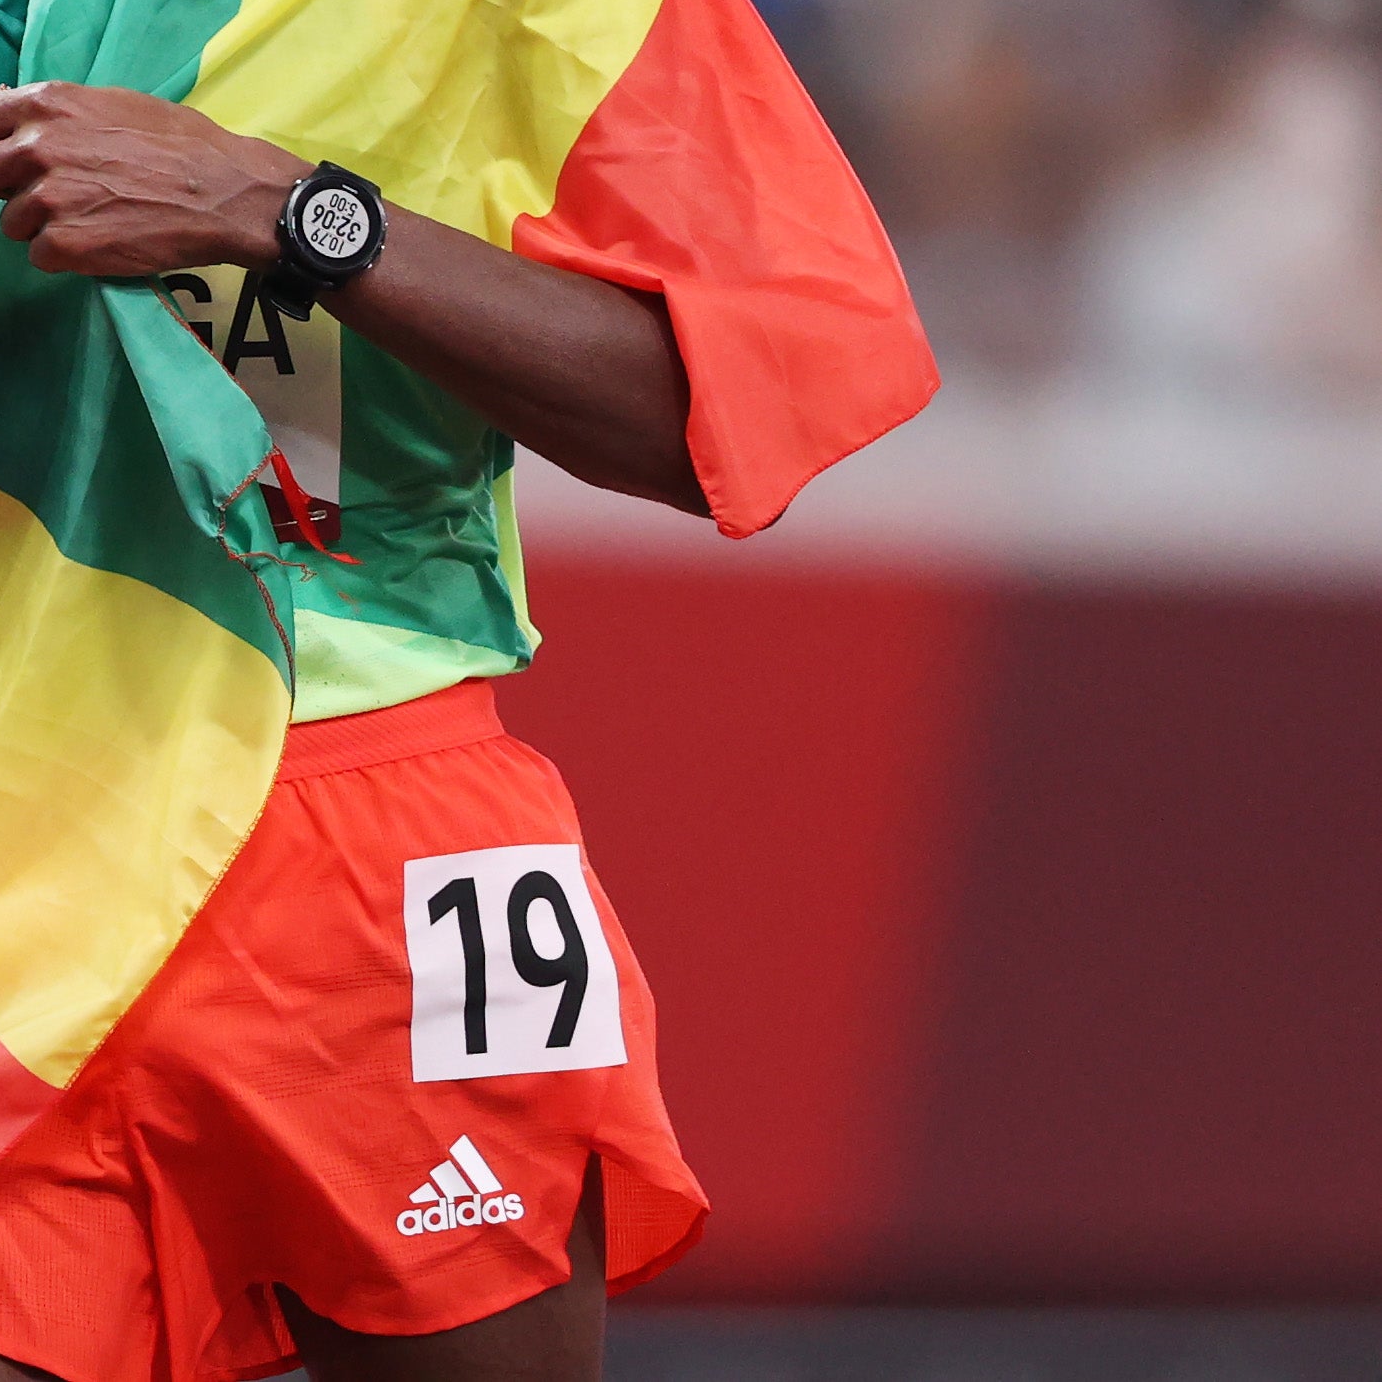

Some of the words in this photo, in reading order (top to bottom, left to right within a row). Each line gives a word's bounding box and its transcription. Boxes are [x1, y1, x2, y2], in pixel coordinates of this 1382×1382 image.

[311, 204, 361, 243] 32:06
[329, 193, 358, 217] 5:00
[310, 228, 345, 255] 10.79
[427, 870, 589, 1055] 19
[396, 1193, 525, 1236] adidas
